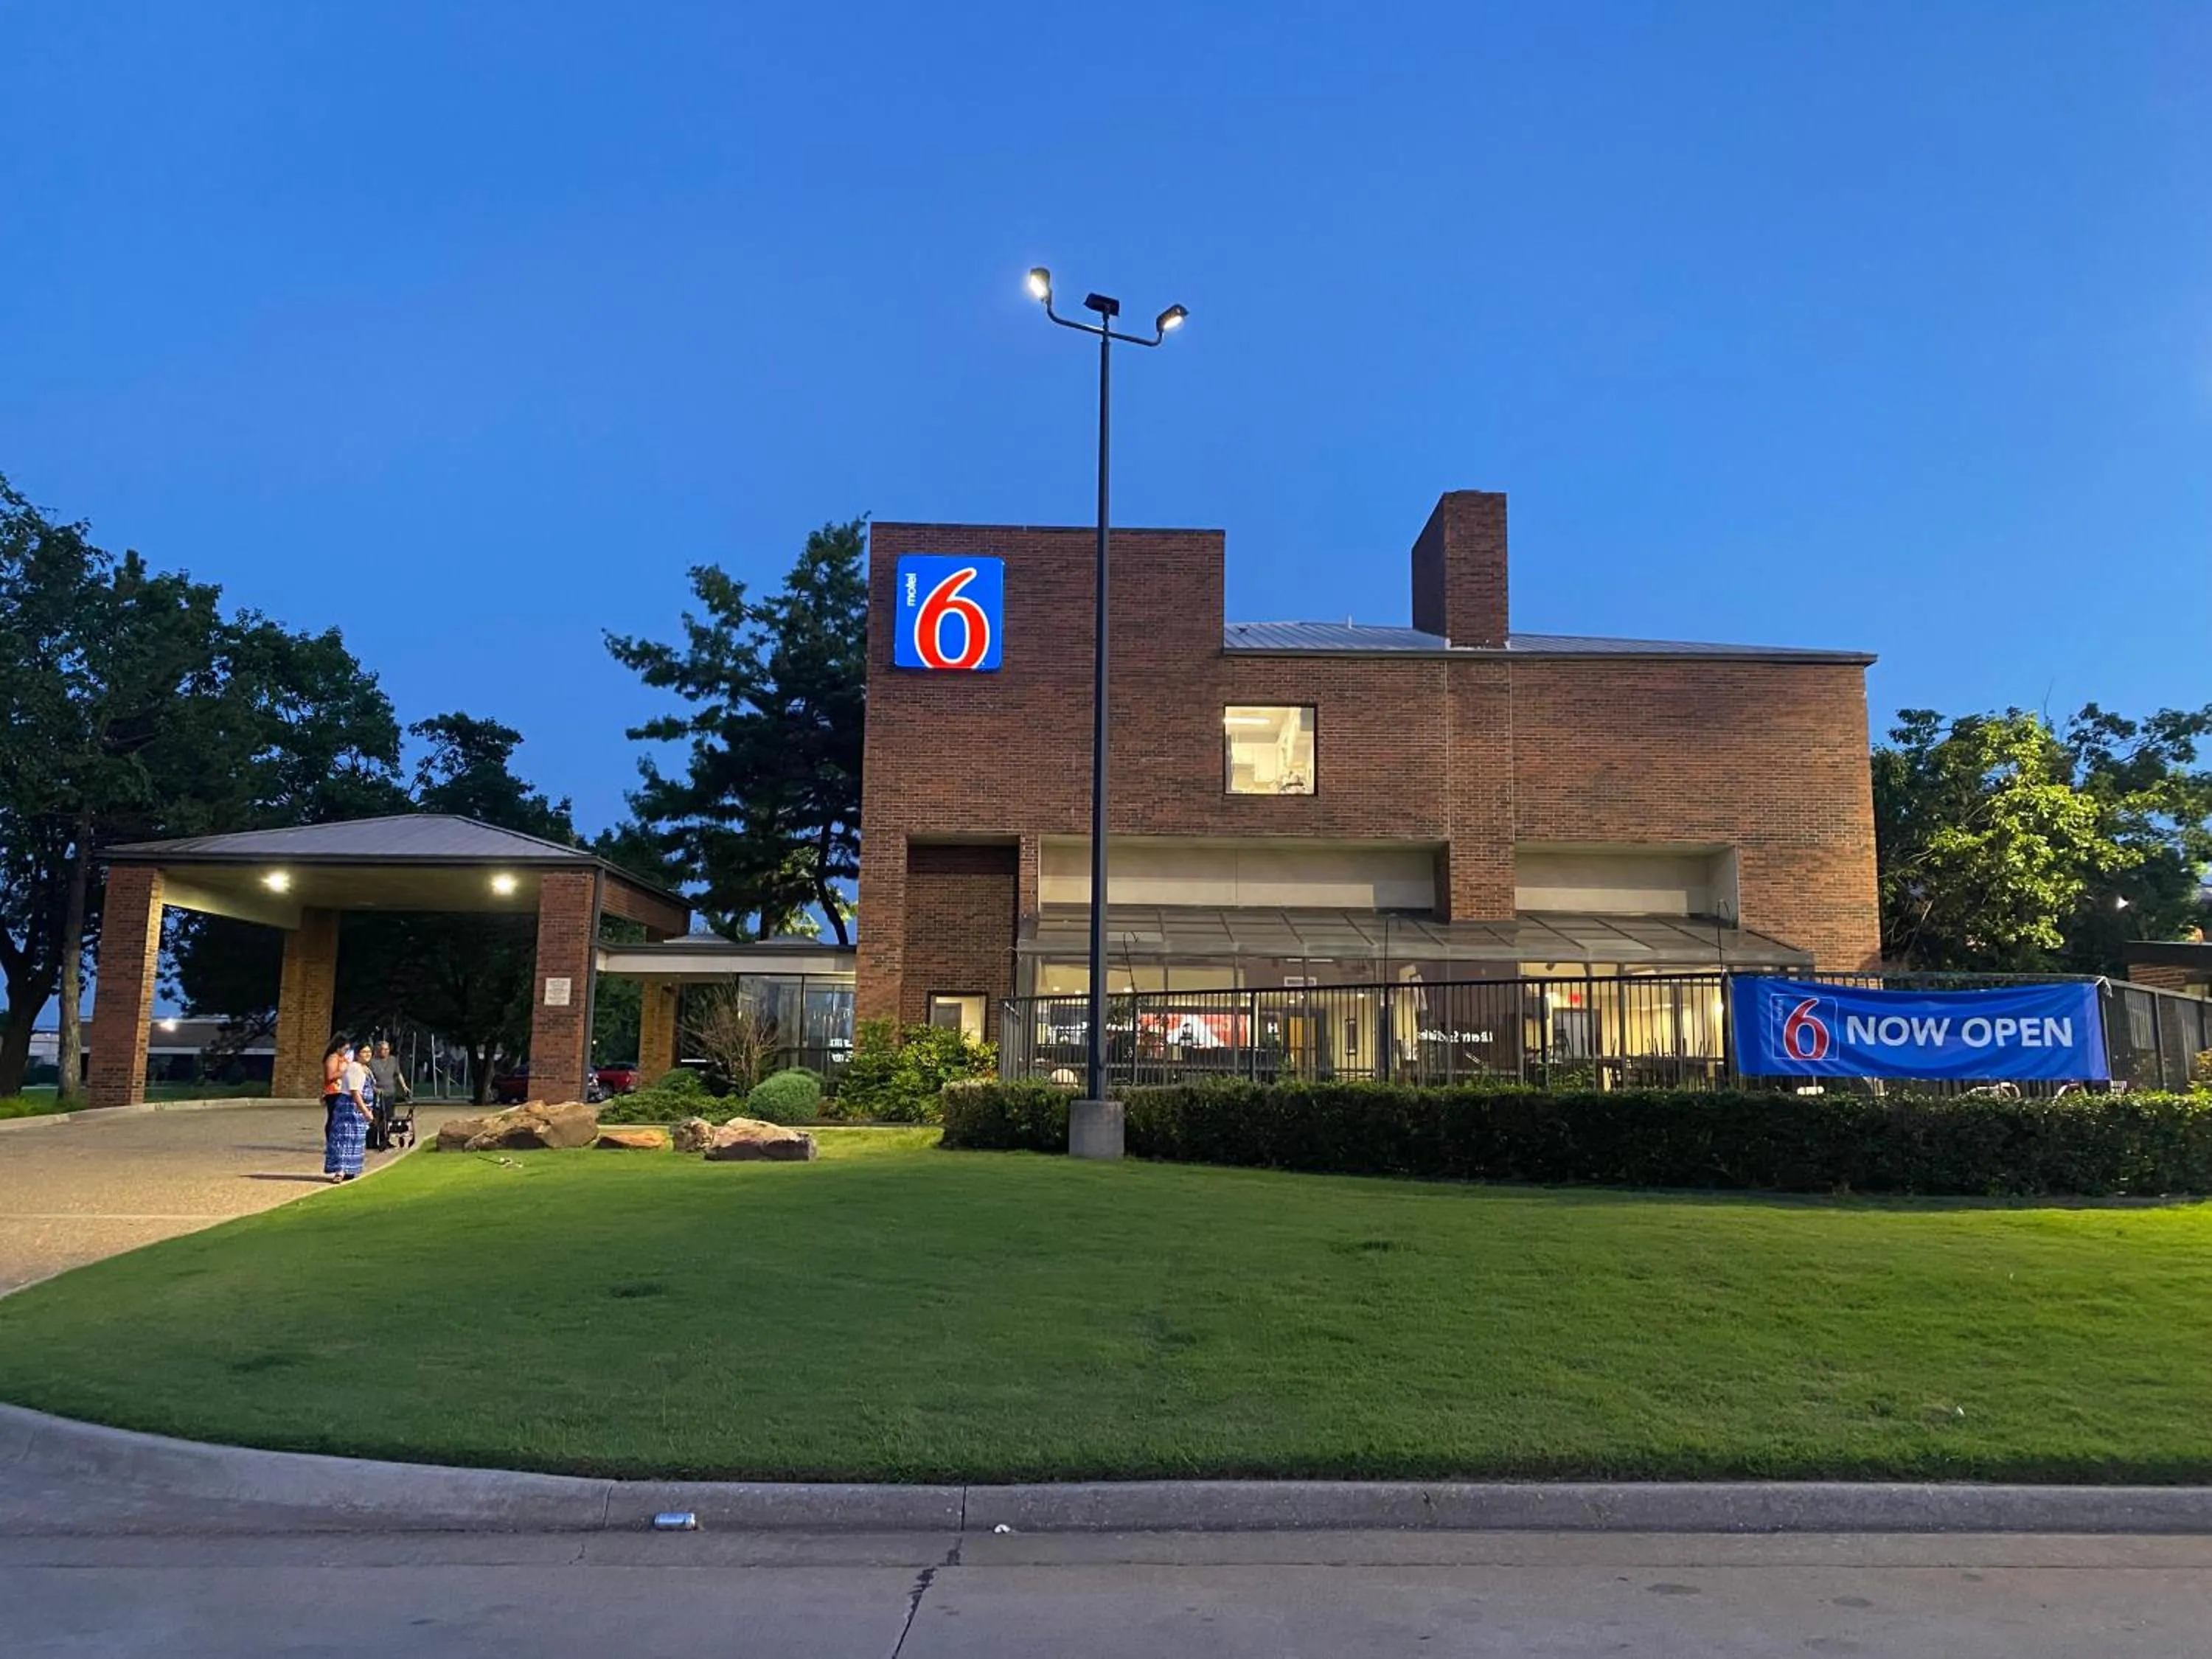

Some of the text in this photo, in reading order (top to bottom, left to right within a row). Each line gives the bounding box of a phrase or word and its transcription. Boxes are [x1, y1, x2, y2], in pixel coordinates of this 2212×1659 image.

[905, 573, 917, 607] motel
[914, 567, 990, 669] 6
[1783, 998, 1829, 1061] 6
[1846, 1015, 2073, 1047] NOW OPEN
